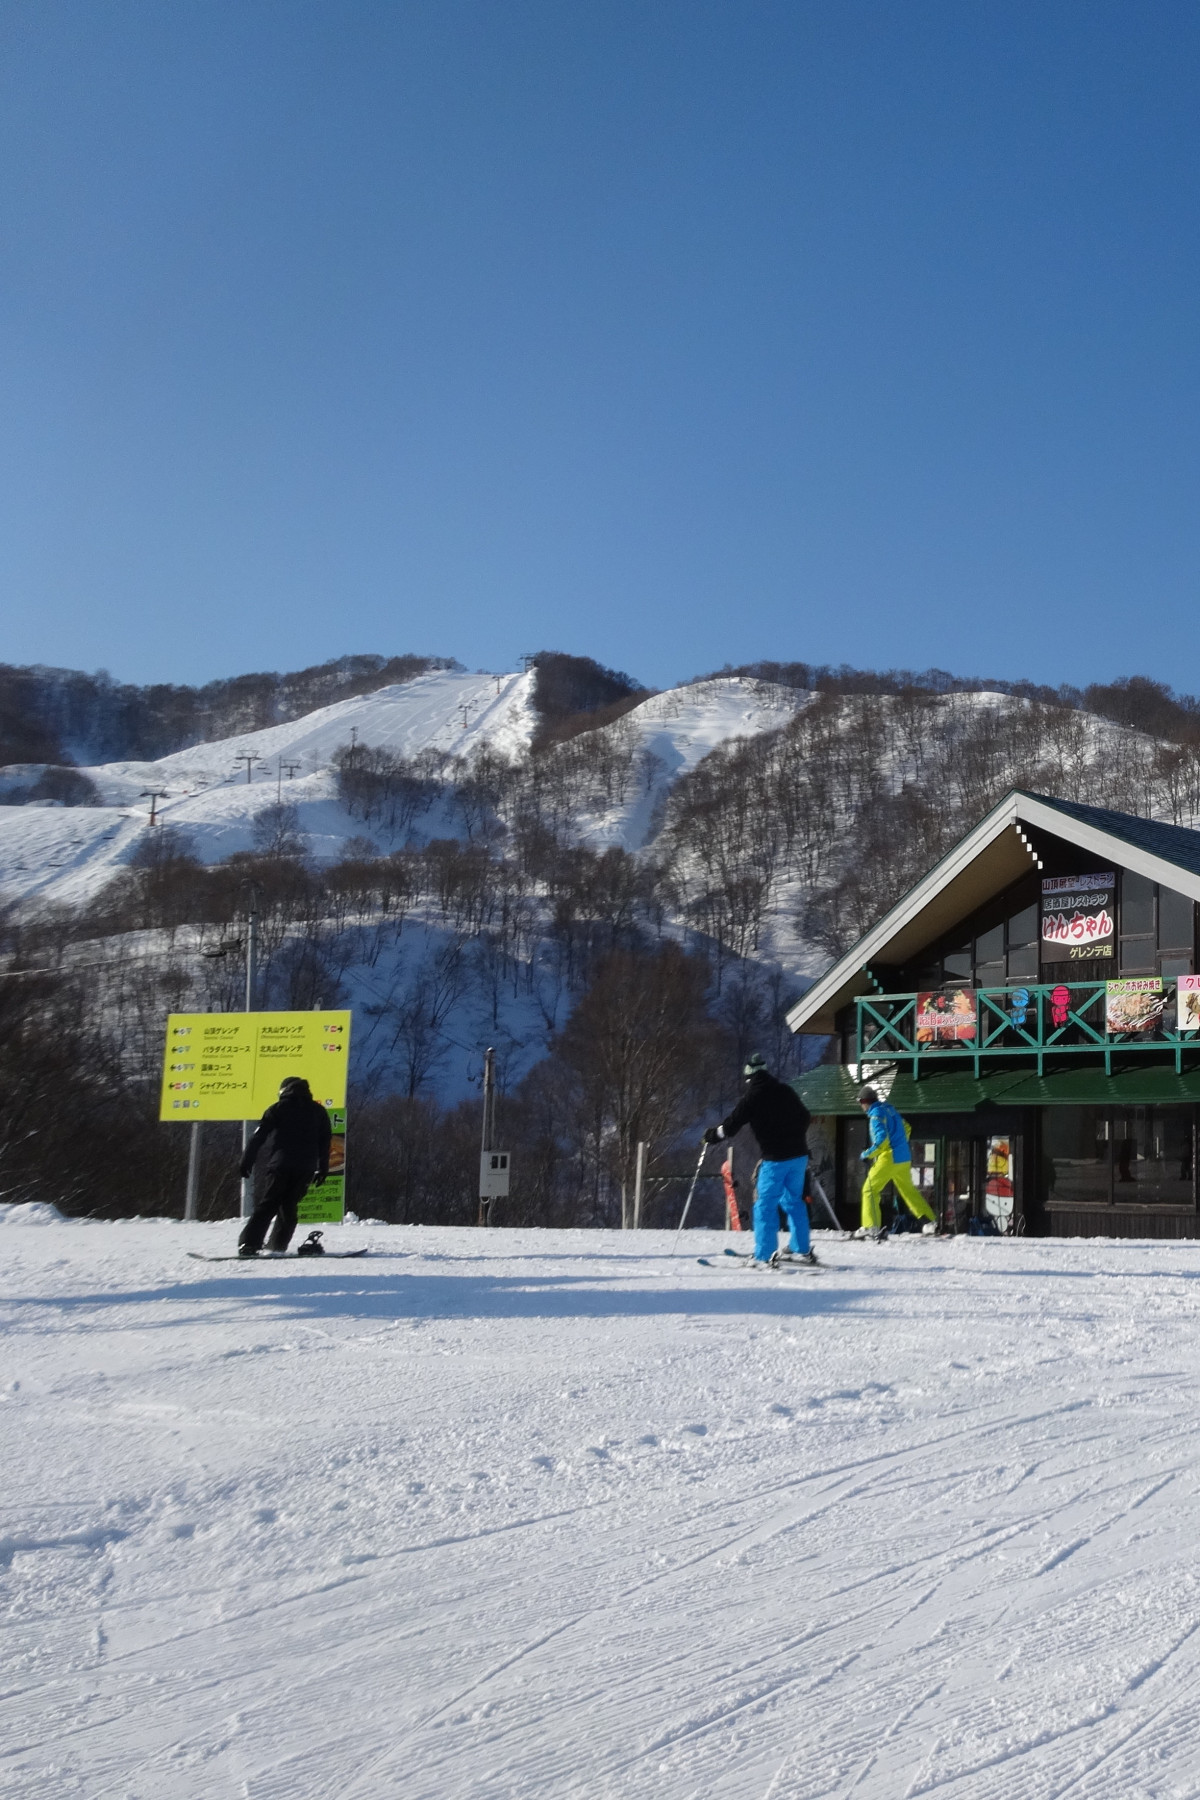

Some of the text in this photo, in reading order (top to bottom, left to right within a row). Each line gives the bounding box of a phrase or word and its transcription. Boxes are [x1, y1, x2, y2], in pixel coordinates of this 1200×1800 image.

[1043, 893, 1109, 911] 居酒屋レストラン
[1043, 911, 1112, 940] けんちゃん
[1069, 945, 1112, 958] ゲレンデ店
